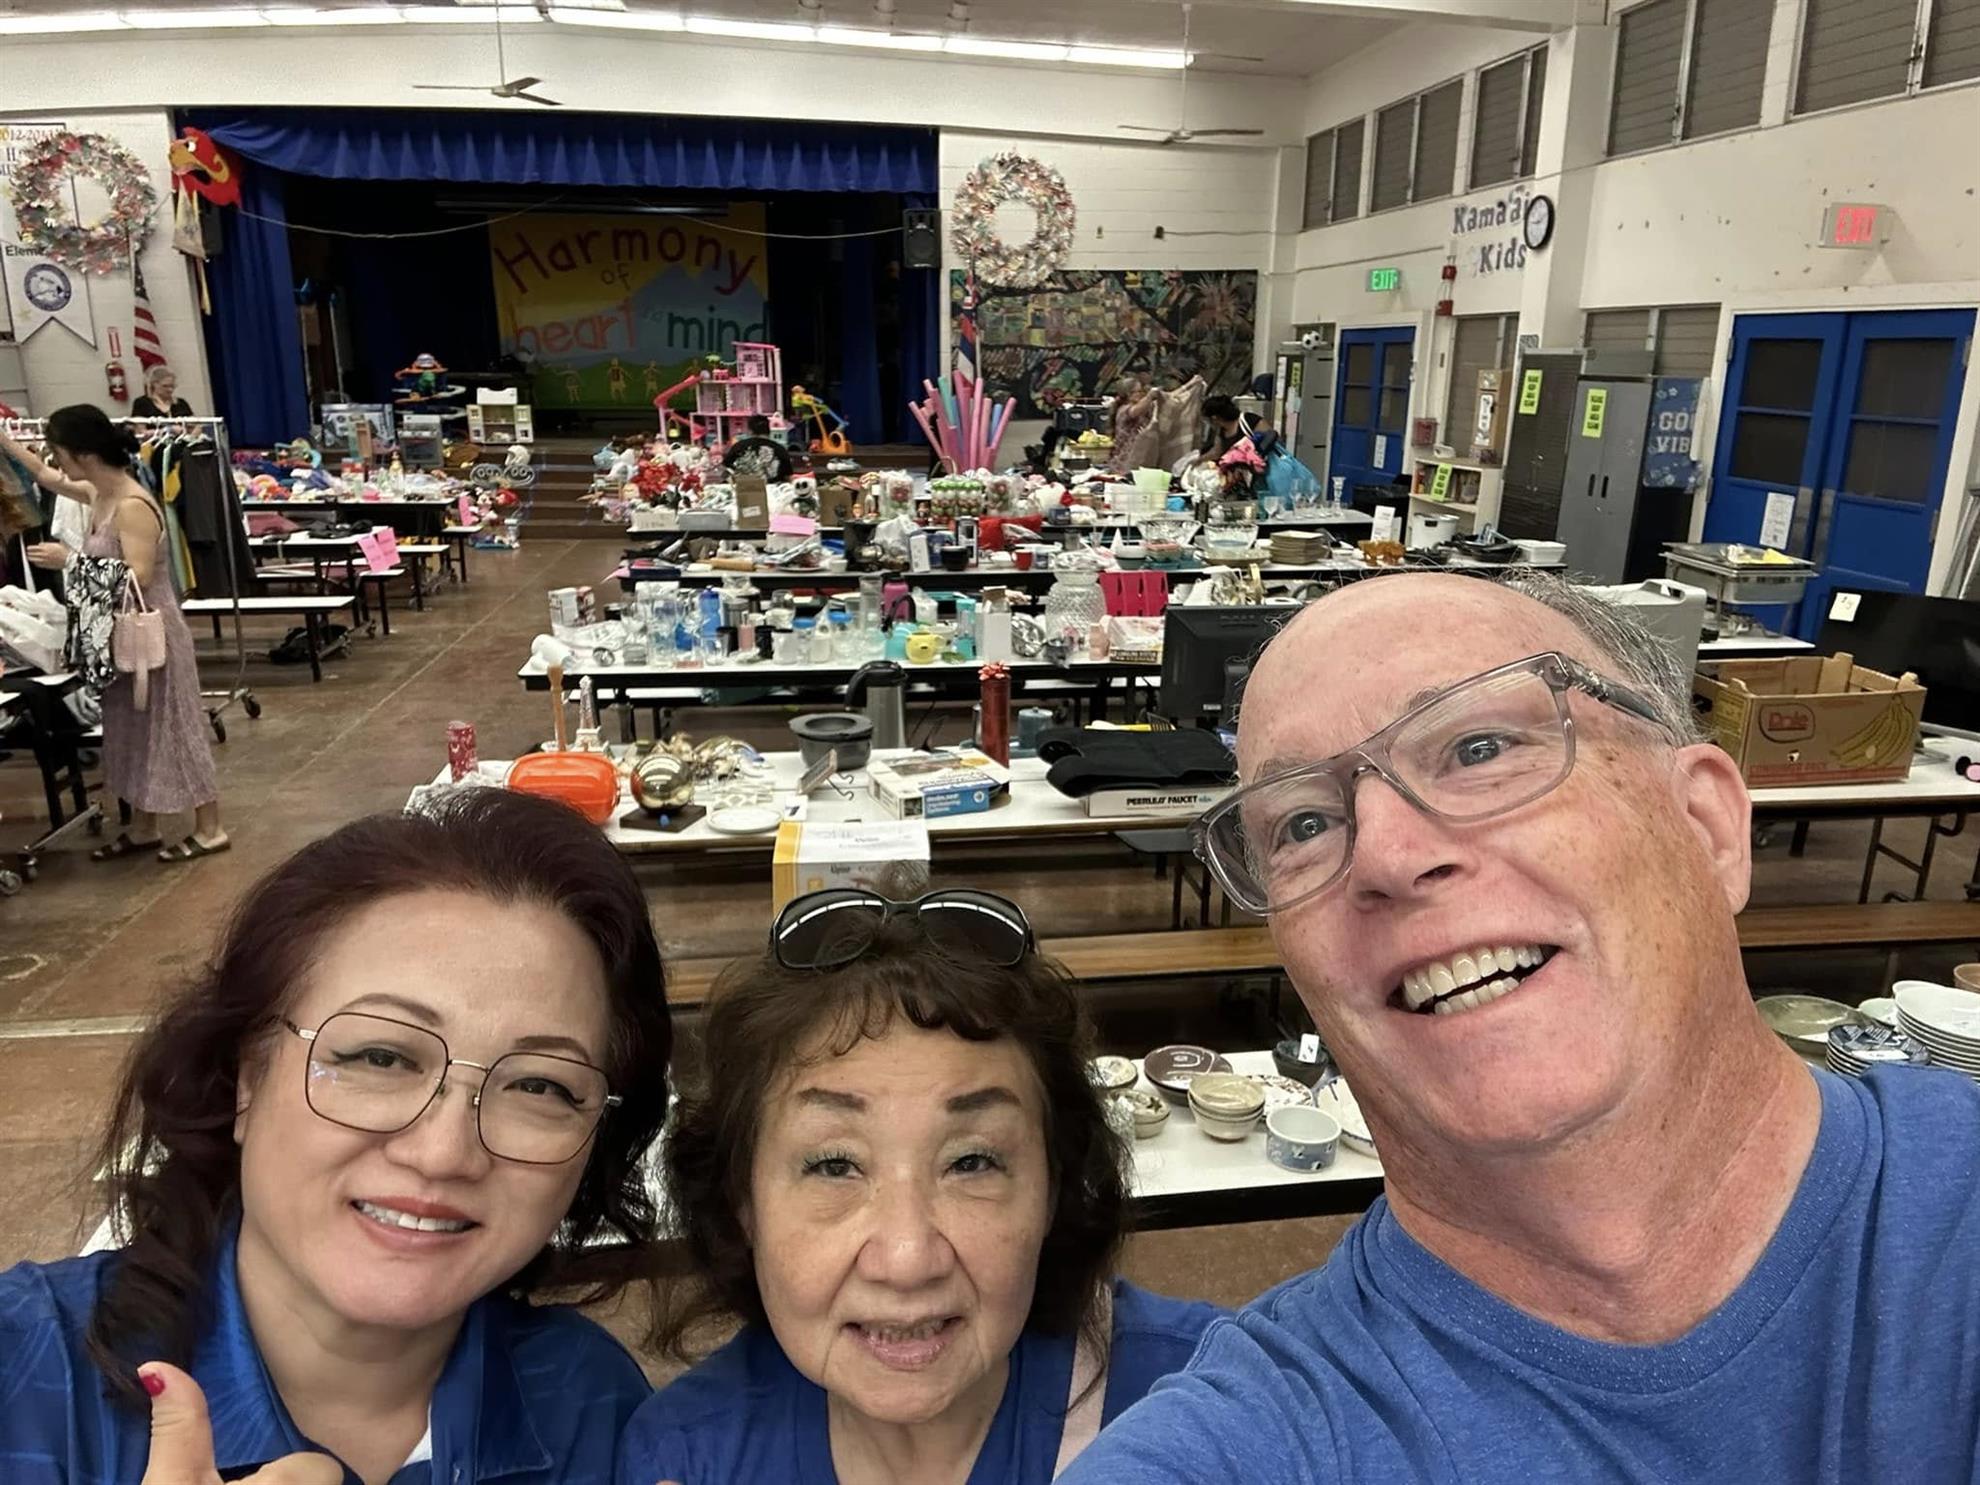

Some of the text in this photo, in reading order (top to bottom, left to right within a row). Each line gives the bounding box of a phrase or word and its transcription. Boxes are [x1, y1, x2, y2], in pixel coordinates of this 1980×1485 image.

[1835, 207, 1877, 243] EXIT
[494, 226, 759, 296] Harmony
[1480, 237, 1527, 273] Kids
[601, 262, 631, 290] of
[1372, 270, 1397, 290] EXIT
[506, 296, 636, 353] heart
[666, 303, 769, 350] mind
[1659, 411, 1696, 431] GO
[1656, 436, 1690, 453] VIB
[1768, 710, 1809, 728] Dole
[1167, 795, 1198, 804] FAUCET
